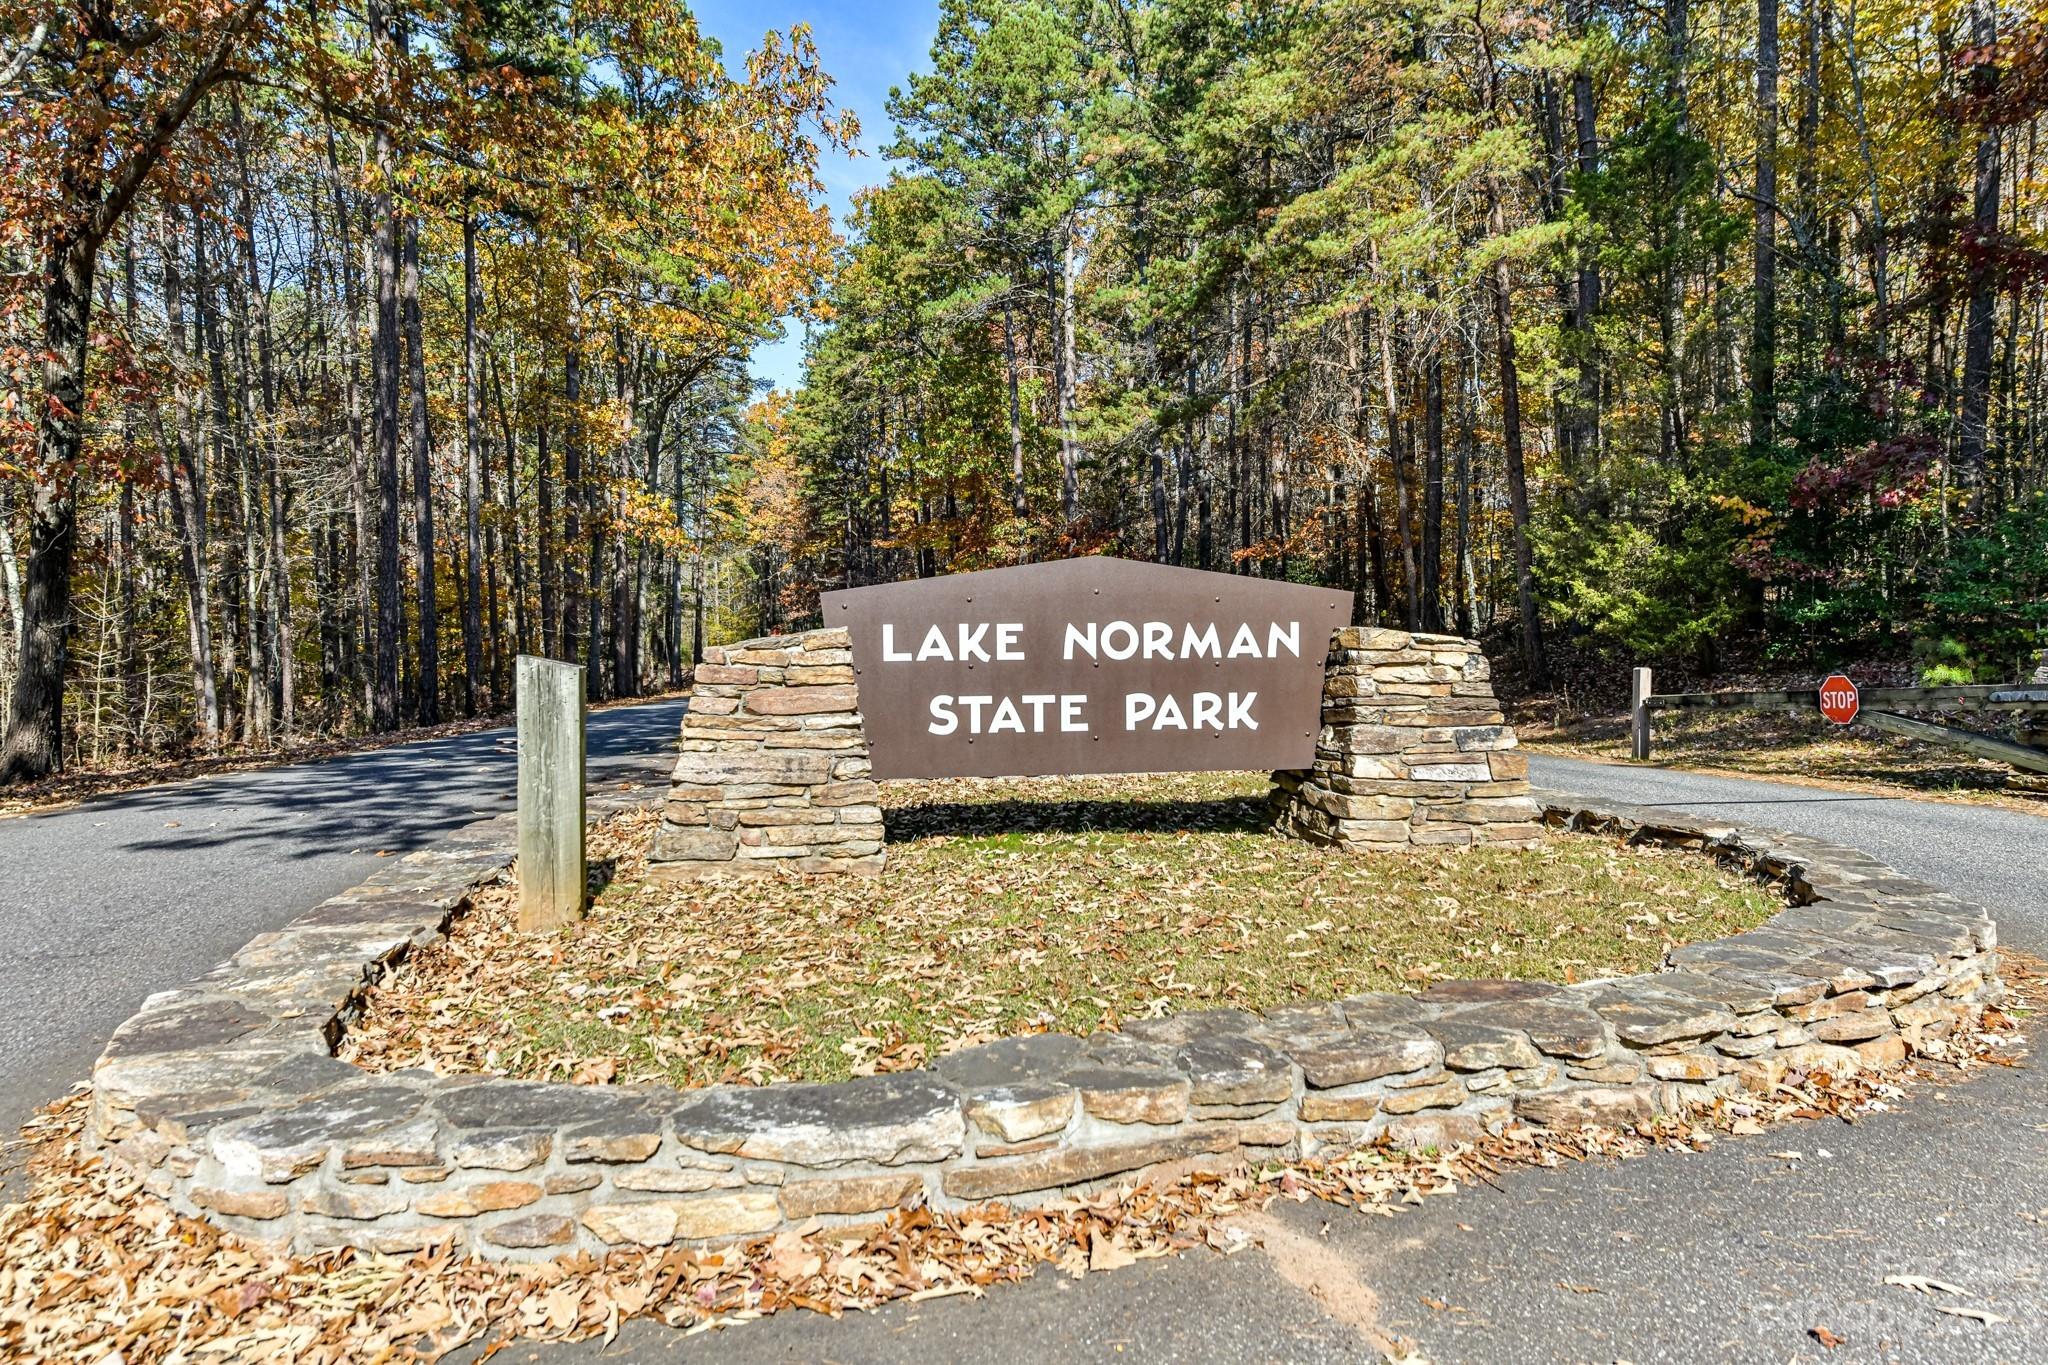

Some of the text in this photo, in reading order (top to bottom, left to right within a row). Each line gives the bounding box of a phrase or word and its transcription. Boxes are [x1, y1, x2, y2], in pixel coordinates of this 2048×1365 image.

[882, 620, 1300, 662] LAKE NORMAN
[927, 691, 1259, 736] STATE PARK
[1823, 691, 1855, 709] STOP
